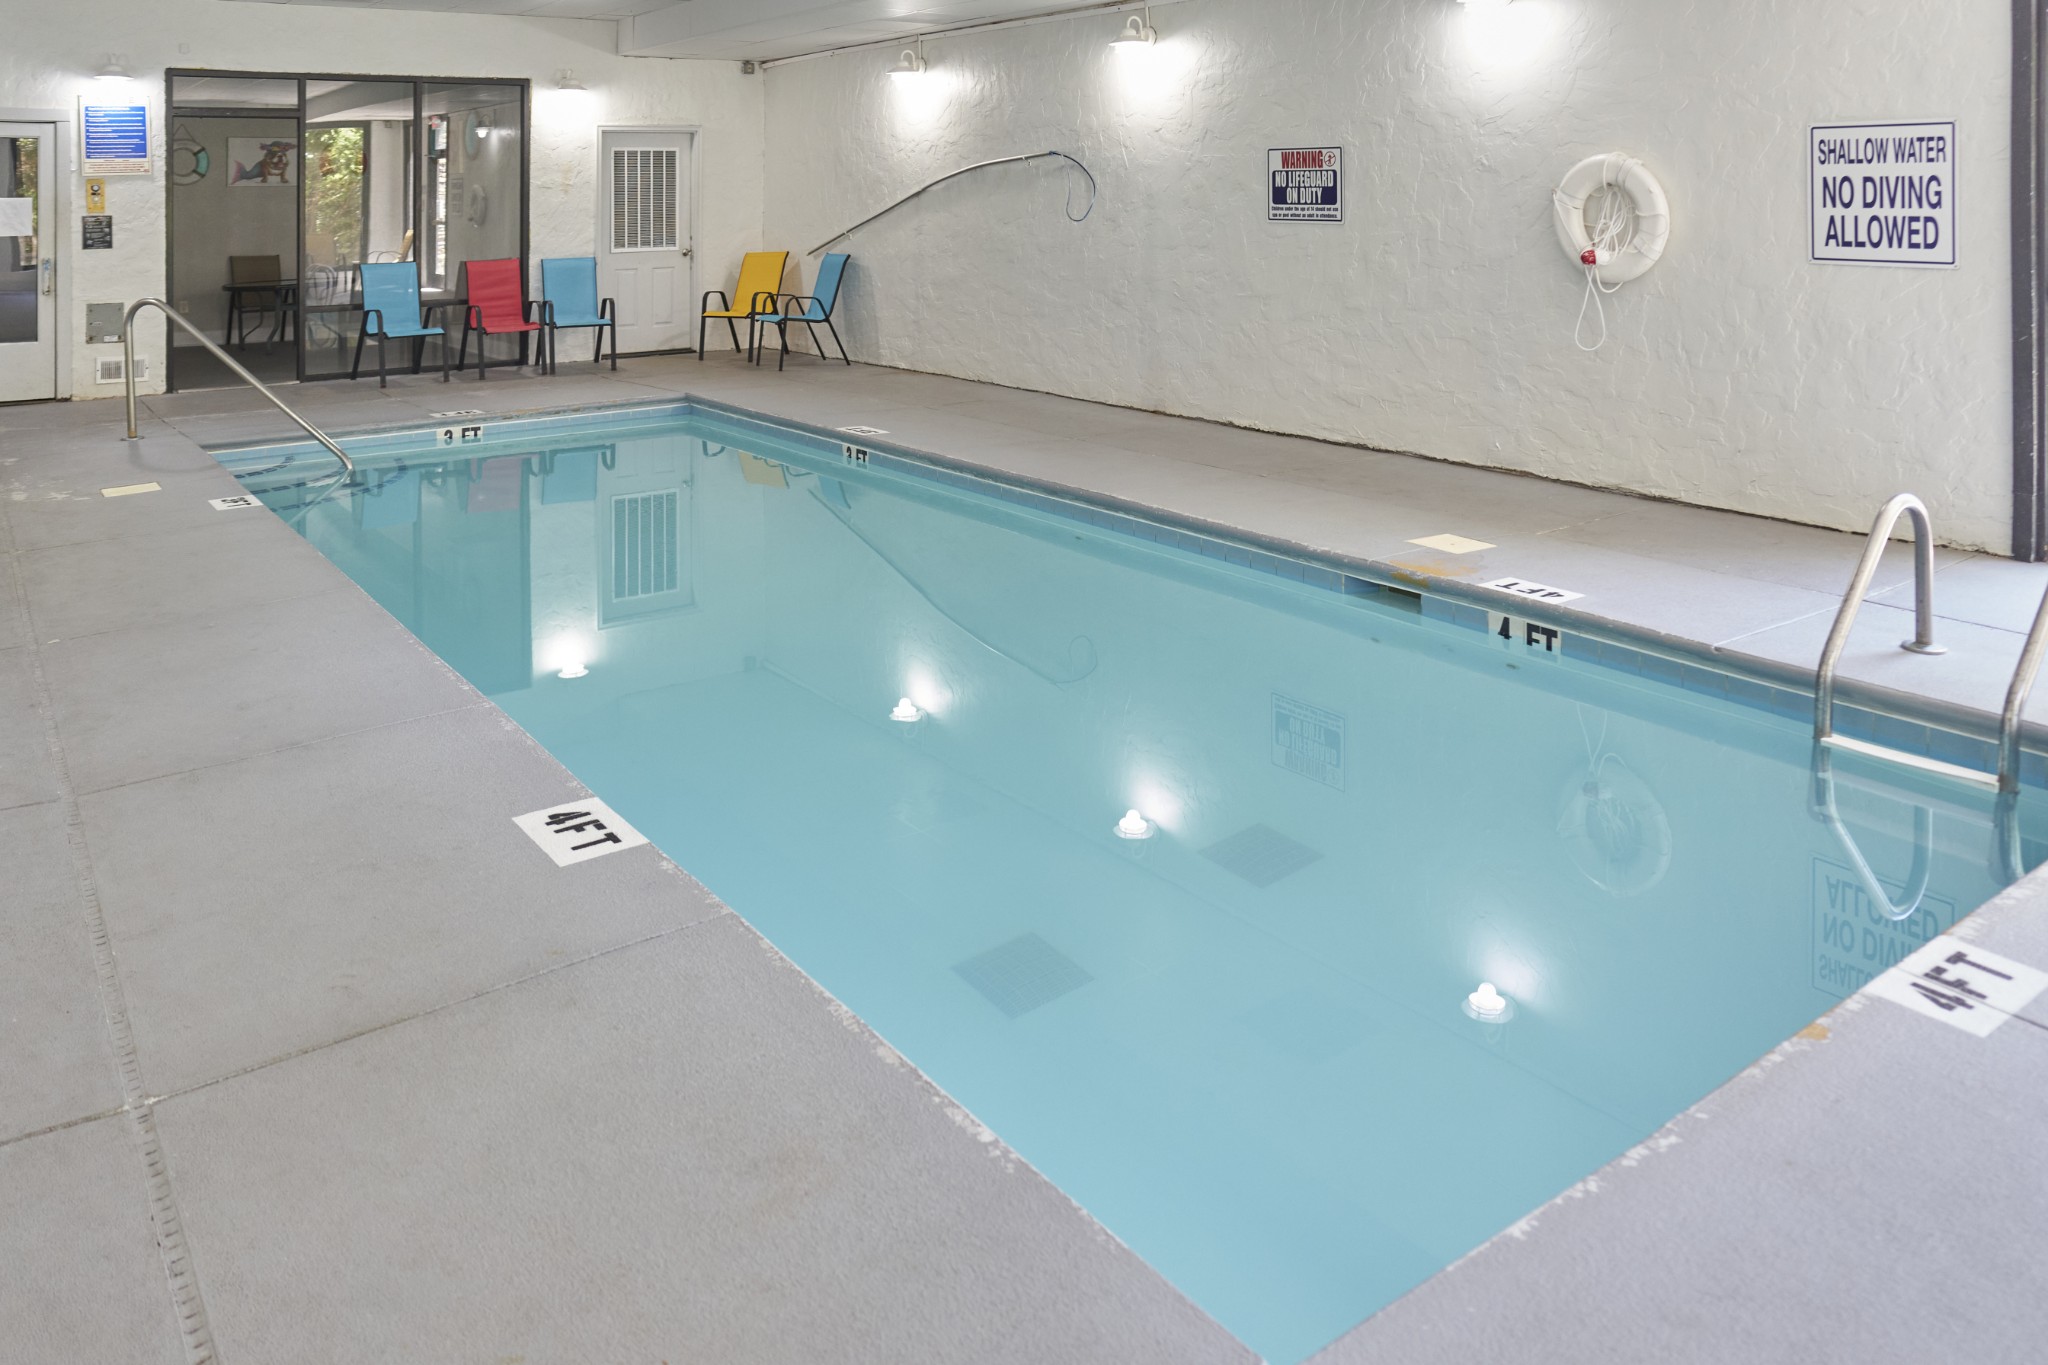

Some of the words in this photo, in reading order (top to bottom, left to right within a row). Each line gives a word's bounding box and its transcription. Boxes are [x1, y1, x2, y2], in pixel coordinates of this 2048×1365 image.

[1281, 150, 1323, 169] WARNING
[1818, 137, 1889, 165] SHALLOW
[1892, 136, 1947, 163] WATER
[1275, 171, 1287, 187] NO
[1288, 170, 1334, 187] LIFEGUARD
[1286, 187, 1298, 204] ON
[1299, 187, 1323, 204] DUTY
[1822, 175, 1855, 209] NO
[1862, 175, 1943, 210] DIVING
[1824, 215, 1940, 249] ALLOWED
[461, 426, 481, 440] FT
[856, 448, 868, 463] FT
[1495, 582, 1565, 598] 4FT
[1497, 616, 1512, 640] 4
[1526, 622, 1558, 652] FT
[544, 811, 622, 851] 4FT
[1909, 950, 2014, 1012] 4FT
